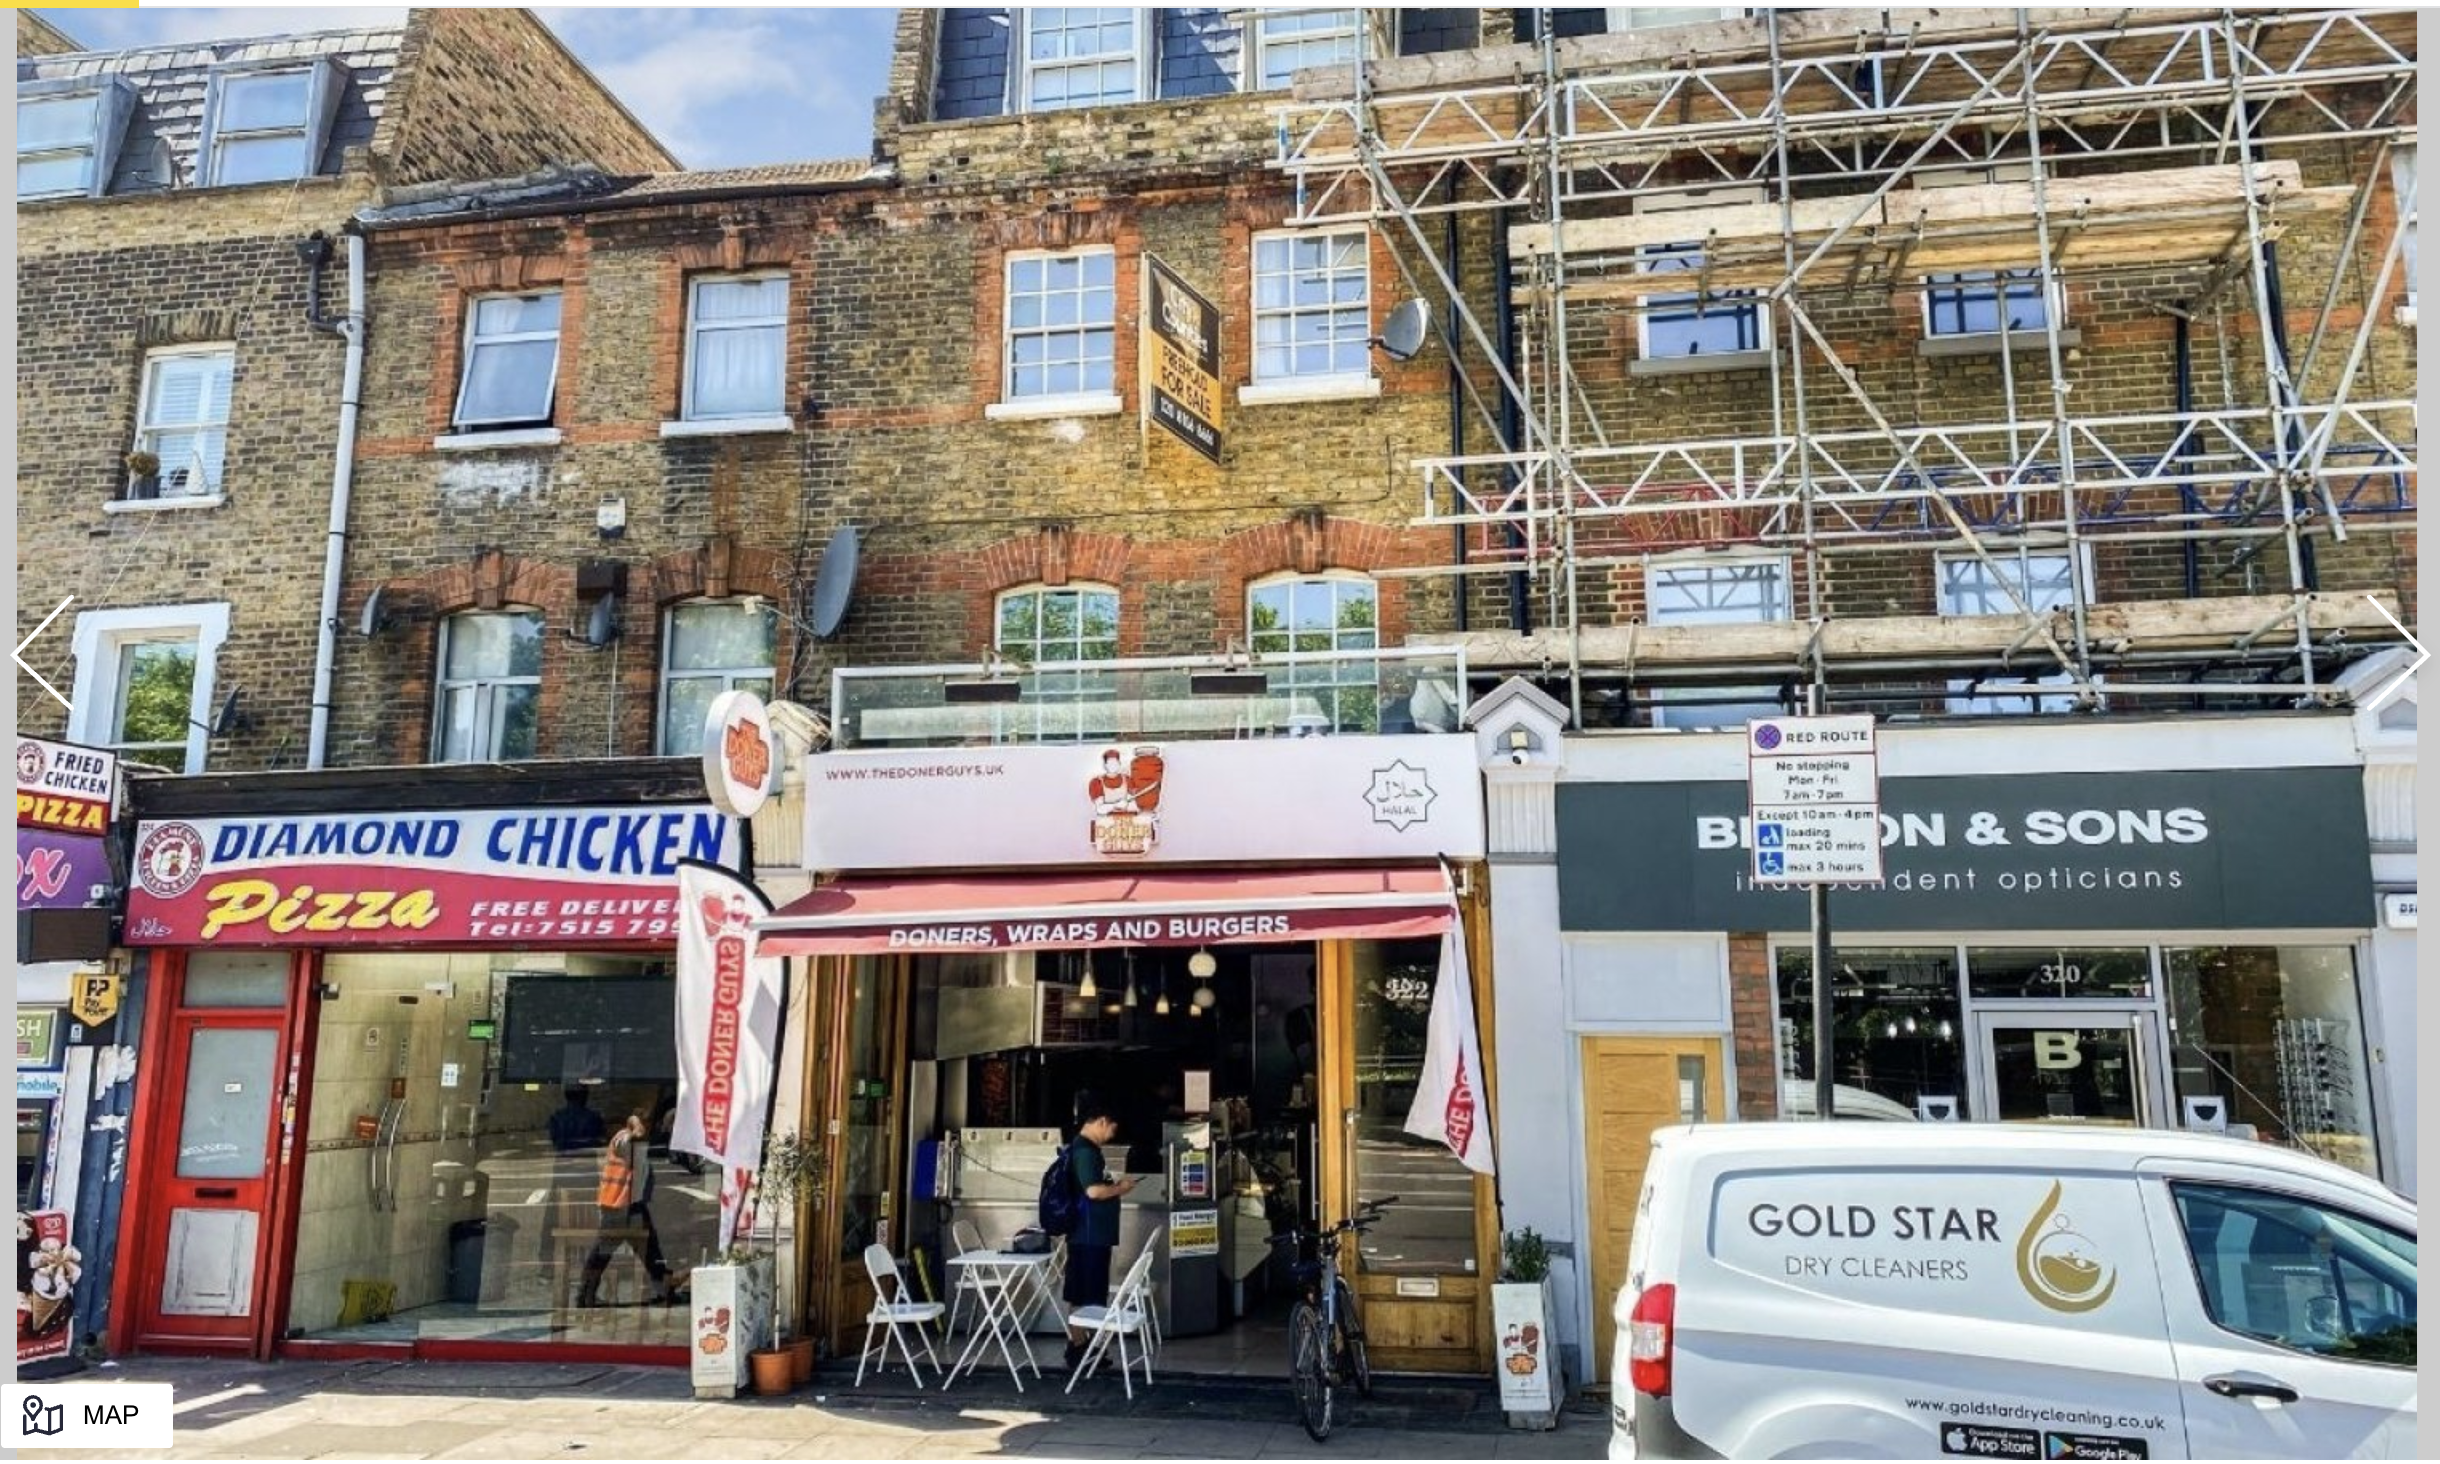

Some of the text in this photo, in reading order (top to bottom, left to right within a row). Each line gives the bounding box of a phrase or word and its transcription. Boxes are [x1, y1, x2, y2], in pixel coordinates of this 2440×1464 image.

[1162, 365, 1212, 420] FOR SALE
[1786, 731, 1868, 743] RED ROUTE
[54, 752, 104, 775] FRIED
[826, 765, 1004, 780] WWW.THEDONERGUYS.UK
[1776, 760, 1850, 772] No stopping
[44, 771, 108, 795] CHICKEN
[1788, 775, 1813, 784] Mon
[1822, 774, 1838, 784] Fri
[17, 792, 103, 829] PIZZA
[1382, 805, 1418, 816] HALAL
[1758, 810, 1799, 821] Except
[1786, 828, 1831, 838] loading
[1965, 811, 2012, 846] &
[2024, 807, 2209, 846] SONS
[210, 813, 726, 876] DIAMOND CHICKEN
[1786, 842, 1865, 851] max 20 mins
[1816, 862, 1825, 871] 3
[1829, 861, 1864, 872] hours
[1998, 867, 2183, 893] opticians
[200, 877, 441, 939] Pizza
[470, 901, 550, 917] FREE
[889, 915, 1290, 948] DONERS, WRAPS AND BURGERS
[2040, 964, 2081, 983] 320
[1385, 977, 1430, 1000] 322
[17, 1019, 42, 1037] SH
[2033, 1030, 2082, 1069] B
[1748, 1203, 2002, 1243] GOLD STAR
[1785, 1255, 1969, 1281] DRY CLEANERS
[1904, 1397, 2166, 1430] www.goldstardrycleaning.co.uk
[1970, 1436, 2036, 1455] App Store
[2074, 1444, 2117, 1460] Google
